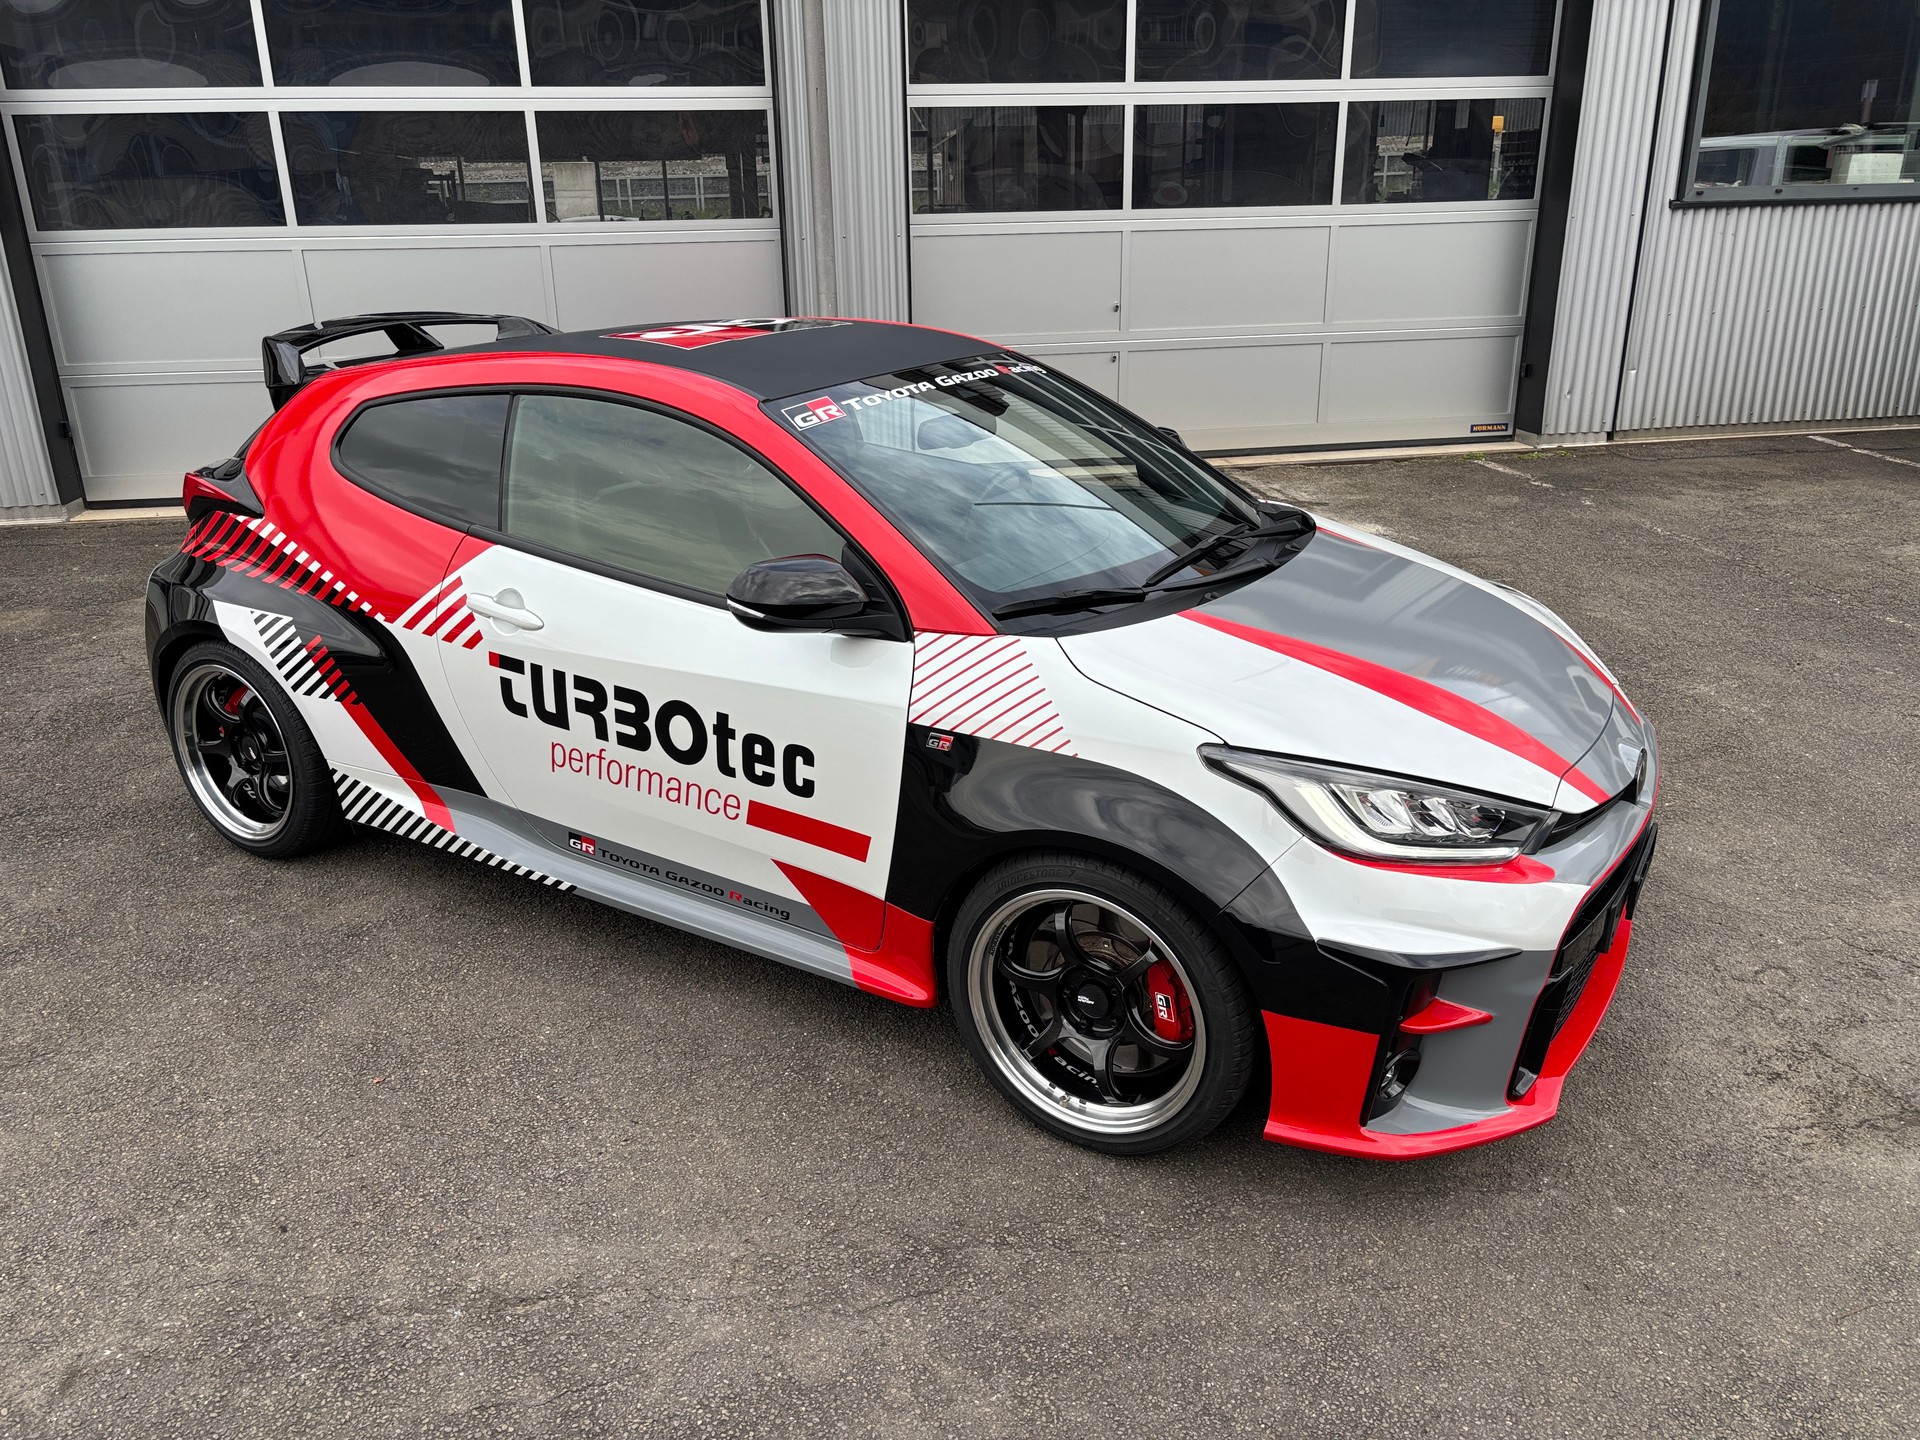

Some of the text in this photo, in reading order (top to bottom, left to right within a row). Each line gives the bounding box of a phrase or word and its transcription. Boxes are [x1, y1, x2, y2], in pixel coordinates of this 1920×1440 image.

[792, 404, 844, 428] GR
[841, 380, 937, 411] TOYOTA
[935, 368, 999, 387] GAZOO
[551, 741, 741, 821] performance
[569, 838, 790, 921] GR TOYOTA GAZOO Racing
[1008, 980, 1039, 1038] AZOO
[1157, 994, 1169, 1019] GR
